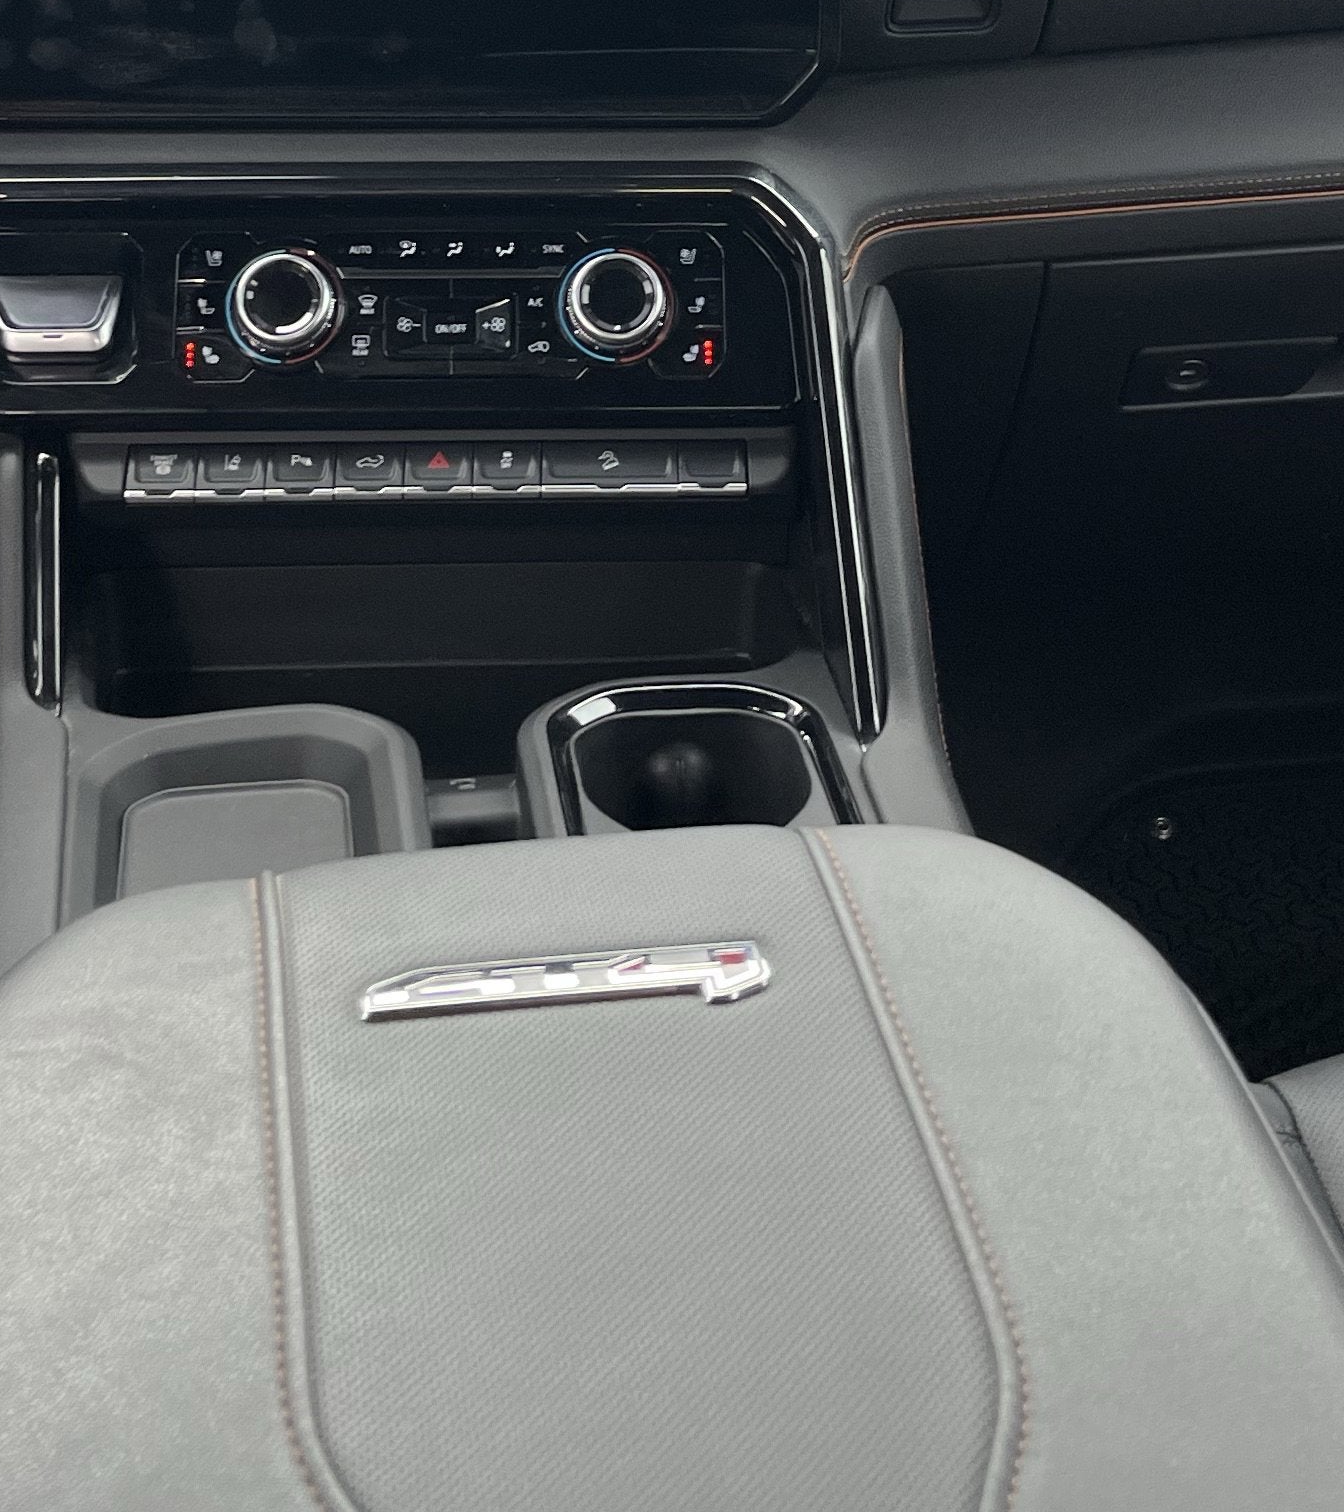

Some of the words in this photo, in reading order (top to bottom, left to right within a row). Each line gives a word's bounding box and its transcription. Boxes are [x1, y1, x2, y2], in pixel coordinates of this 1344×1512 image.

[348, 245, 372, 255] AUTO
[527, 297, 544, 307] A/C
[435, 323, 467, 334] ON/OFF
